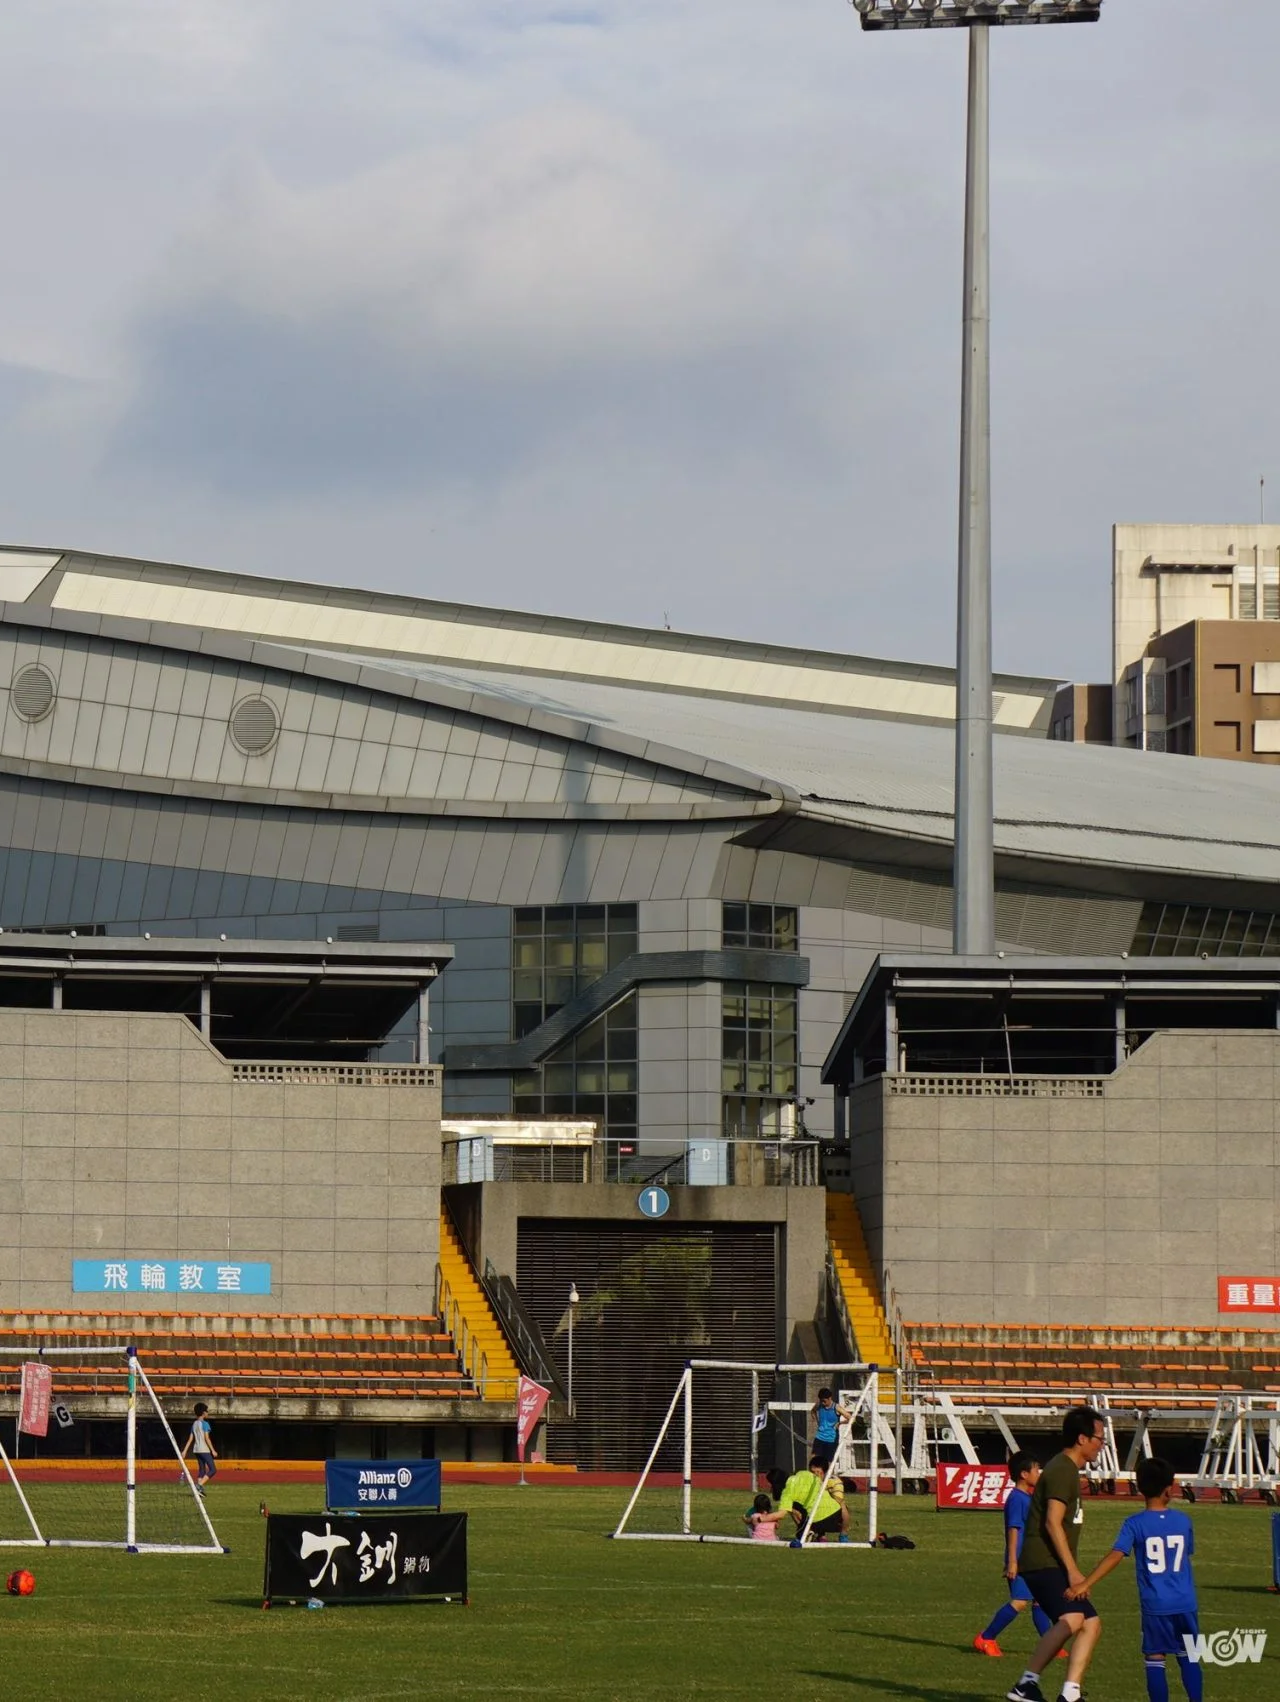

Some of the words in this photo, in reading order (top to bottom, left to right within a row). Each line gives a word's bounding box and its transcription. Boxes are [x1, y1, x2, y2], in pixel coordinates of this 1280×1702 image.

[702, 1148, 711, 1161] D
[648, 1191, 658, 1213] 1
[104, 1263, 242, 1291] 飛輪教室
[1227, 1284, 1280, 1306] 重量
[56, 1406, 70, 1422] G
[358, 1470, 396, 1485] Allianz
[357, 1488, 397, 1501] 安聯人壽
[1145, 1534, 1185, 1574] 97
